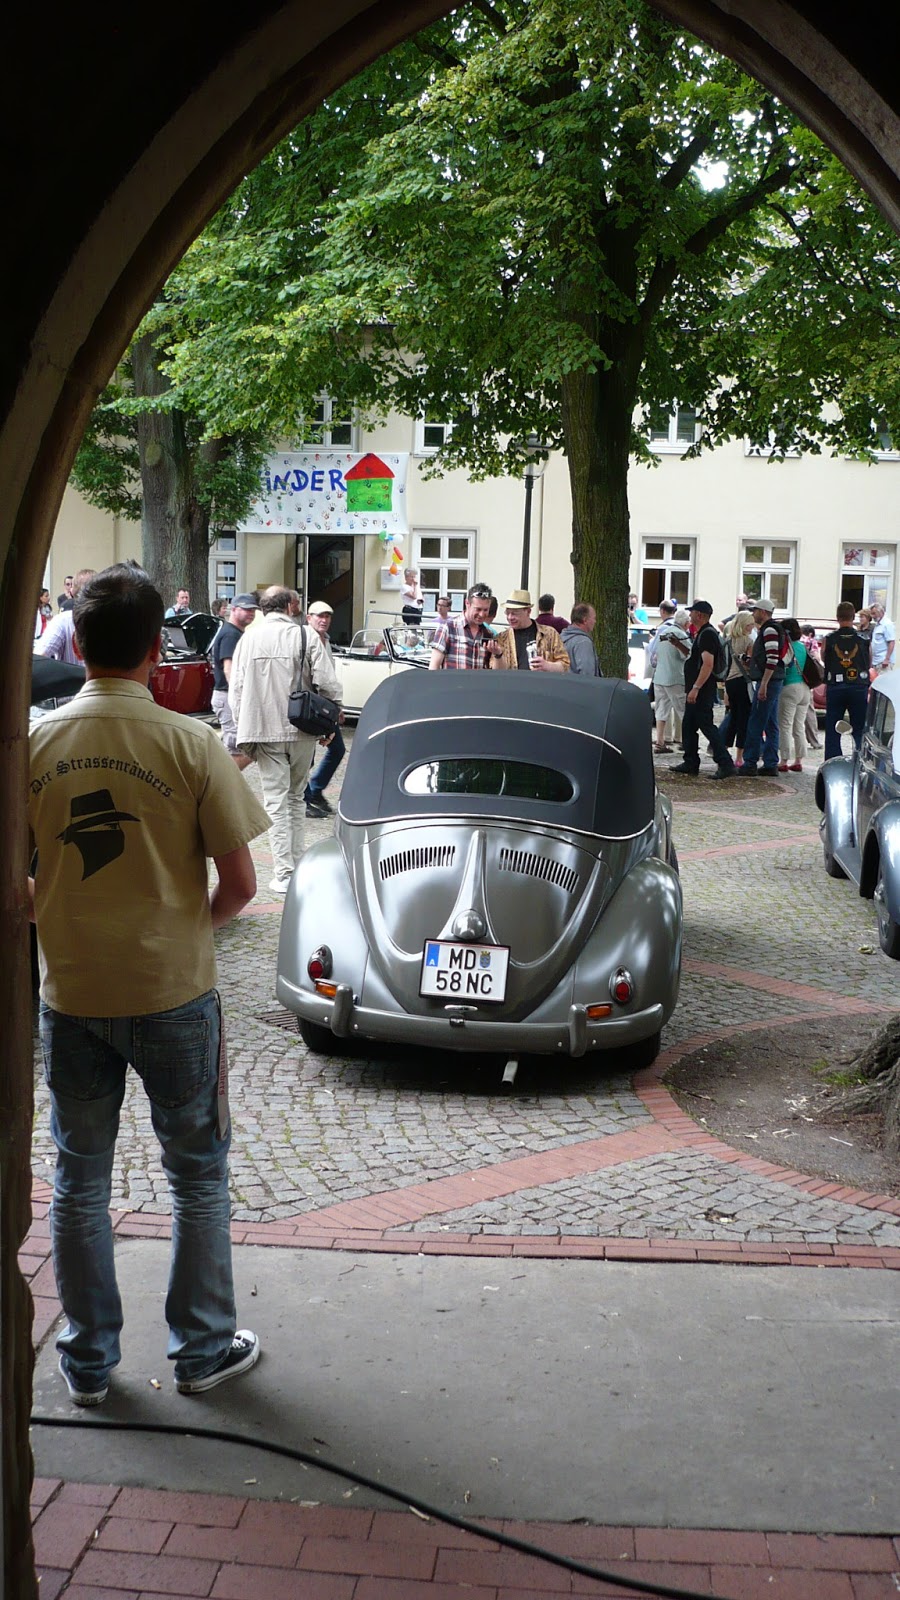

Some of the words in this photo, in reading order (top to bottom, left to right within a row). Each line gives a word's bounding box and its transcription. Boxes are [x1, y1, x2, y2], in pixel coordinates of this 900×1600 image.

[258, 469, 348, 492] iNDER
[30, 770, 52, 795] Der
[56, 756, 175, 798] Strassenräubers
[429, 958, 436, 966] A
[449, 948, 477, 970] MD
[436, 970, 462, 992] 58
[466, 972, 493, 995] NC
